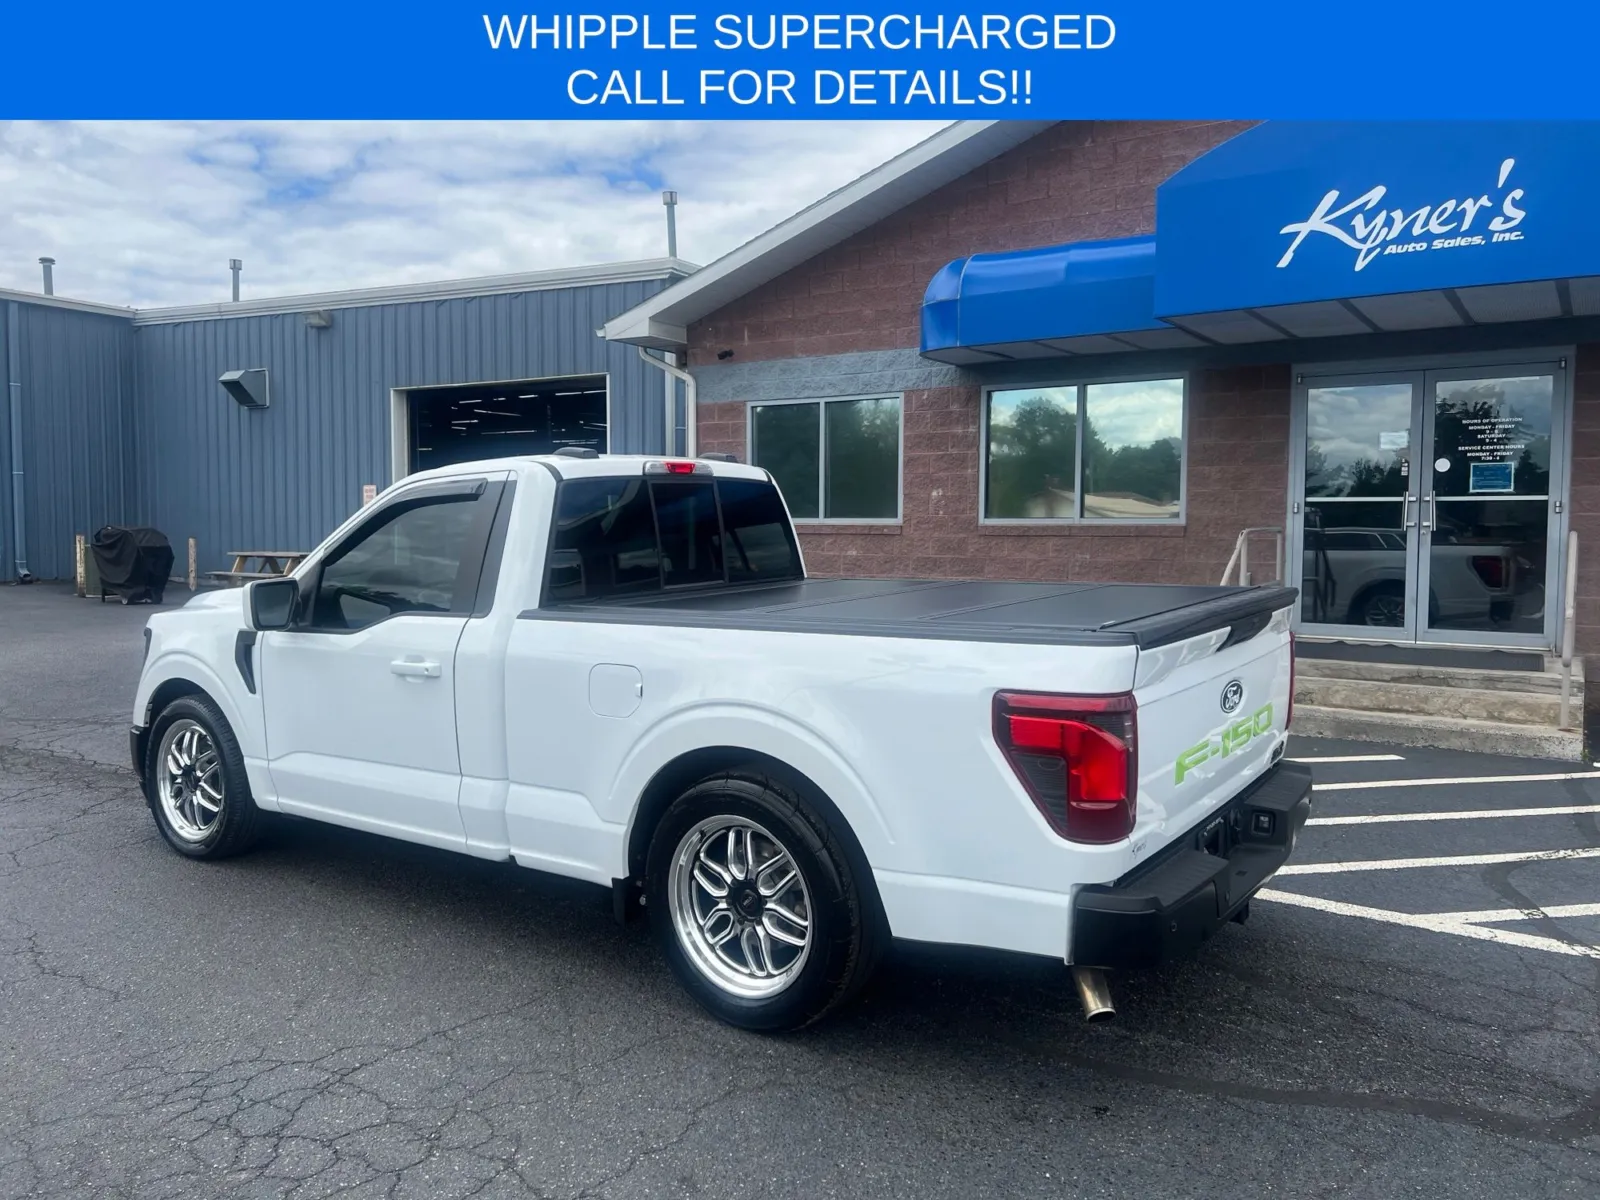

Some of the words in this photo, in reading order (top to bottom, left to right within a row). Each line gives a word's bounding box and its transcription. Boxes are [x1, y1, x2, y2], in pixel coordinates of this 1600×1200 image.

[1276, 158, 1526, 272] Kyner's
[1383, 242, 1428, 255] Auto
[1431, 235, 1487, 249] Sales,
[1492, 231, 1524, 243] Inc.
[1174, 701, 1273, 787] F-150
